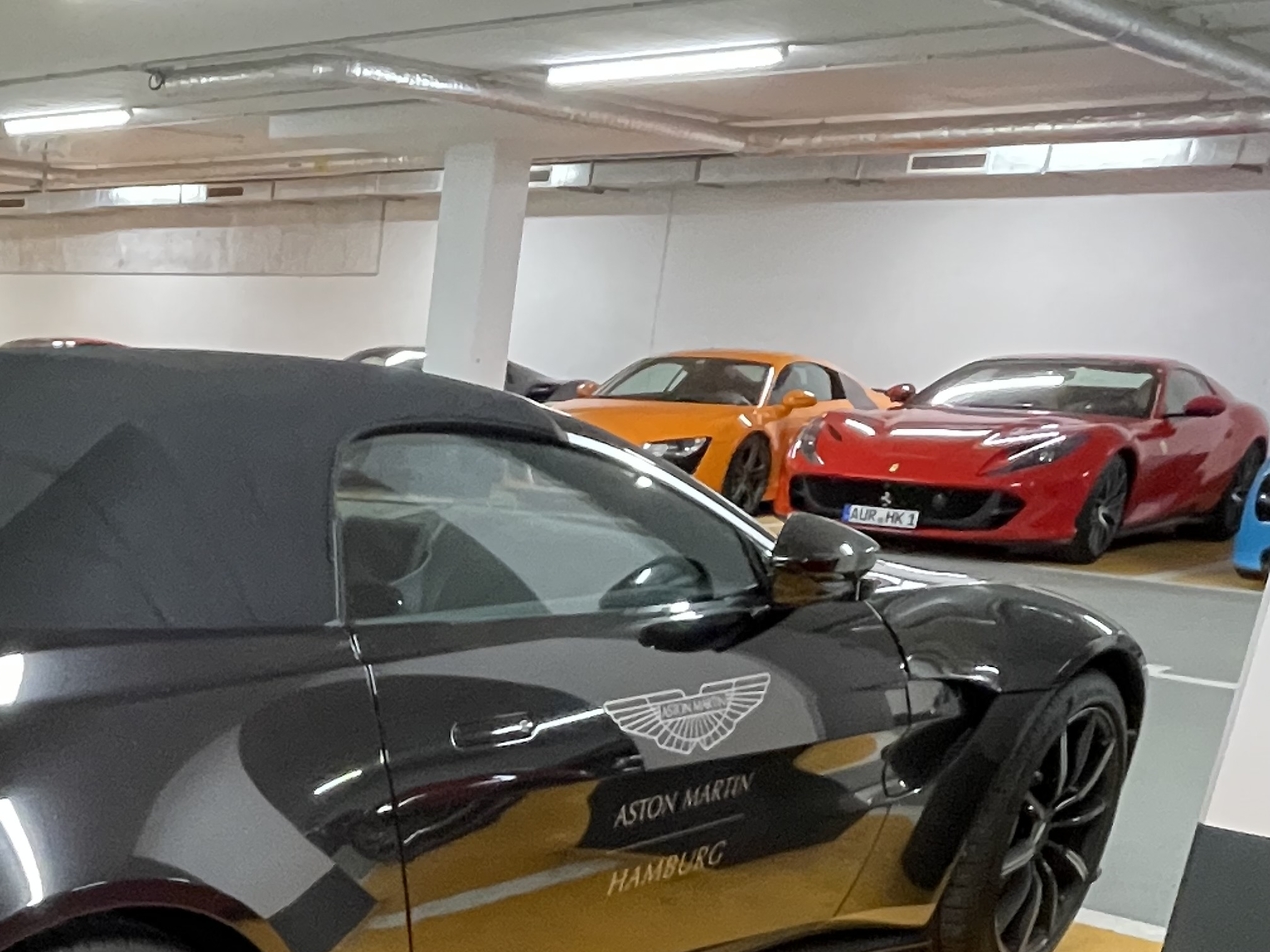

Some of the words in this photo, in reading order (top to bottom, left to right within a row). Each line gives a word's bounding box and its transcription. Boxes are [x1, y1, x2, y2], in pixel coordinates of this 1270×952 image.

[851, 508, 877, 522] AUR
[885, 511, 903, 525] HK
[908, 514, 915, 526] 1
[613, 790, 677, 828] ASTON
[681, 772, 755, 810] MARTIN
[607, 840, 727, 896] HAMBURG
